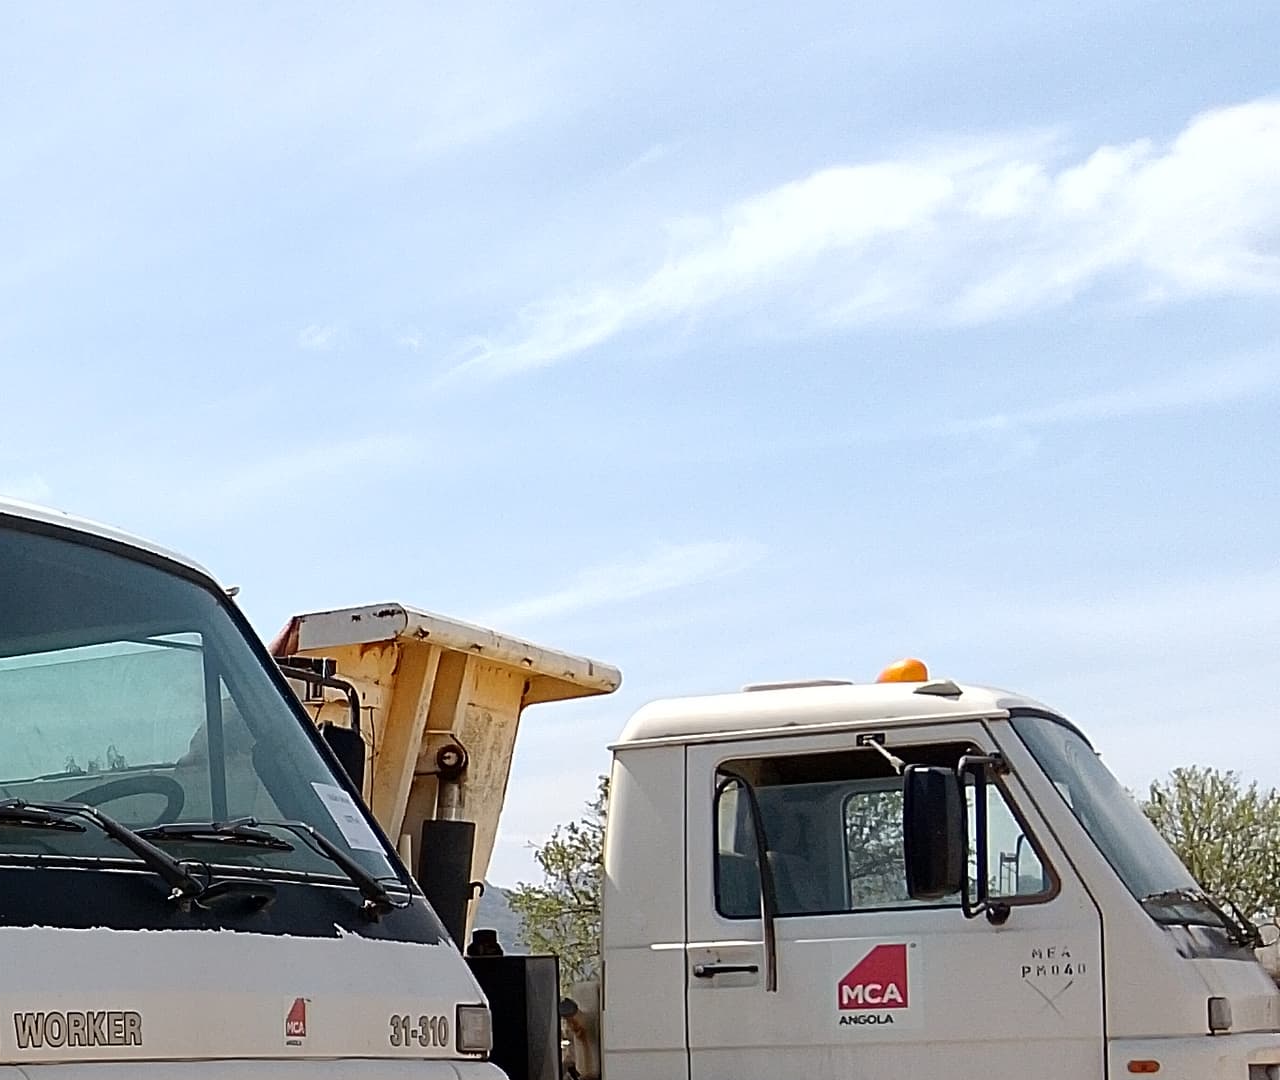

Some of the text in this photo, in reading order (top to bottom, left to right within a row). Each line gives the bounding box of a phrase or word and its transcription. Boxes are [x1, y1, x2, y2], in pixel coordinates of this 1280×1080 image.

[842, 983, 903, 1004] MCA
[14, 1011, 143, 1048] WORKER
[389, 1015, 450, 1047] 31-310
[839, 1015, 894, 1025] ANGOLA
